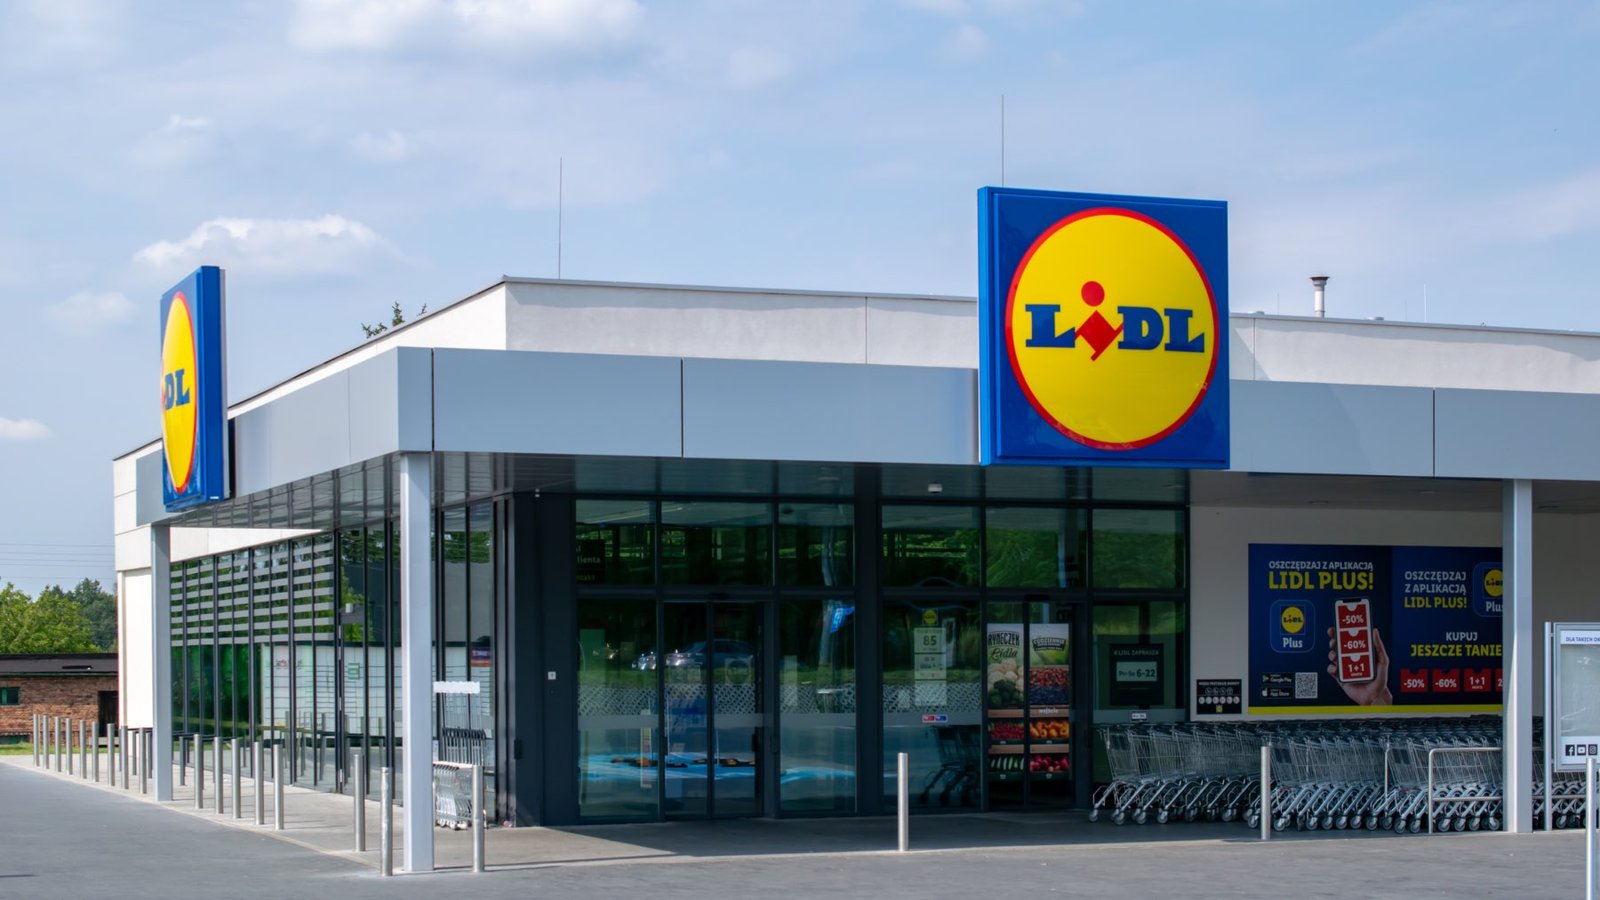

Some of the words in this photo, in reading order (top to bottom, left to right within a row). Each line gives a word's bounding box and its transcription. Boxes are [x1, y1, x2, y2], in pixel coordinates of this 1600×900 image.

[1268, 561, 1321, 571] OSZCZĘDZAJ
[1322, 561, 1328, 570] Z
[1329, 561, 1374, 572] APLIKACJĄ
[1268, 571, 1315, 590] LIDL
[1318, 571, 1374, 590] PLUS!
[1404, 571, 1467, 583] OSZCZĘDZAJ
[1404, 584, 1411, 593] Z
[1413, 584, 1467, 595] APLIKACJĄ
[1404, 596, 1432, 608] LIDL
[1433, 596, 1467, 608] PLUS!
[1342, 615, 1364, 624] -50%
[923, 635, 937, 646] 85
[1445, 632, 1478, 641] KUPUJ
[1282, 637, 1303, 648] Plus
[1344, 640, 1366, 649] -60%
[1410, 644, 1463, 657] JESZCZE
[1464, 644, 1503, 657] TANIE
[1136, 668, 1155, 677] 6-22
[1348, 663, 1365, 673] 1+1
[1403, 679, 1425, 688] -50%
[1434, 679, 1457, 688] -60%
[1469, 677, 1485, 685] 1+1
